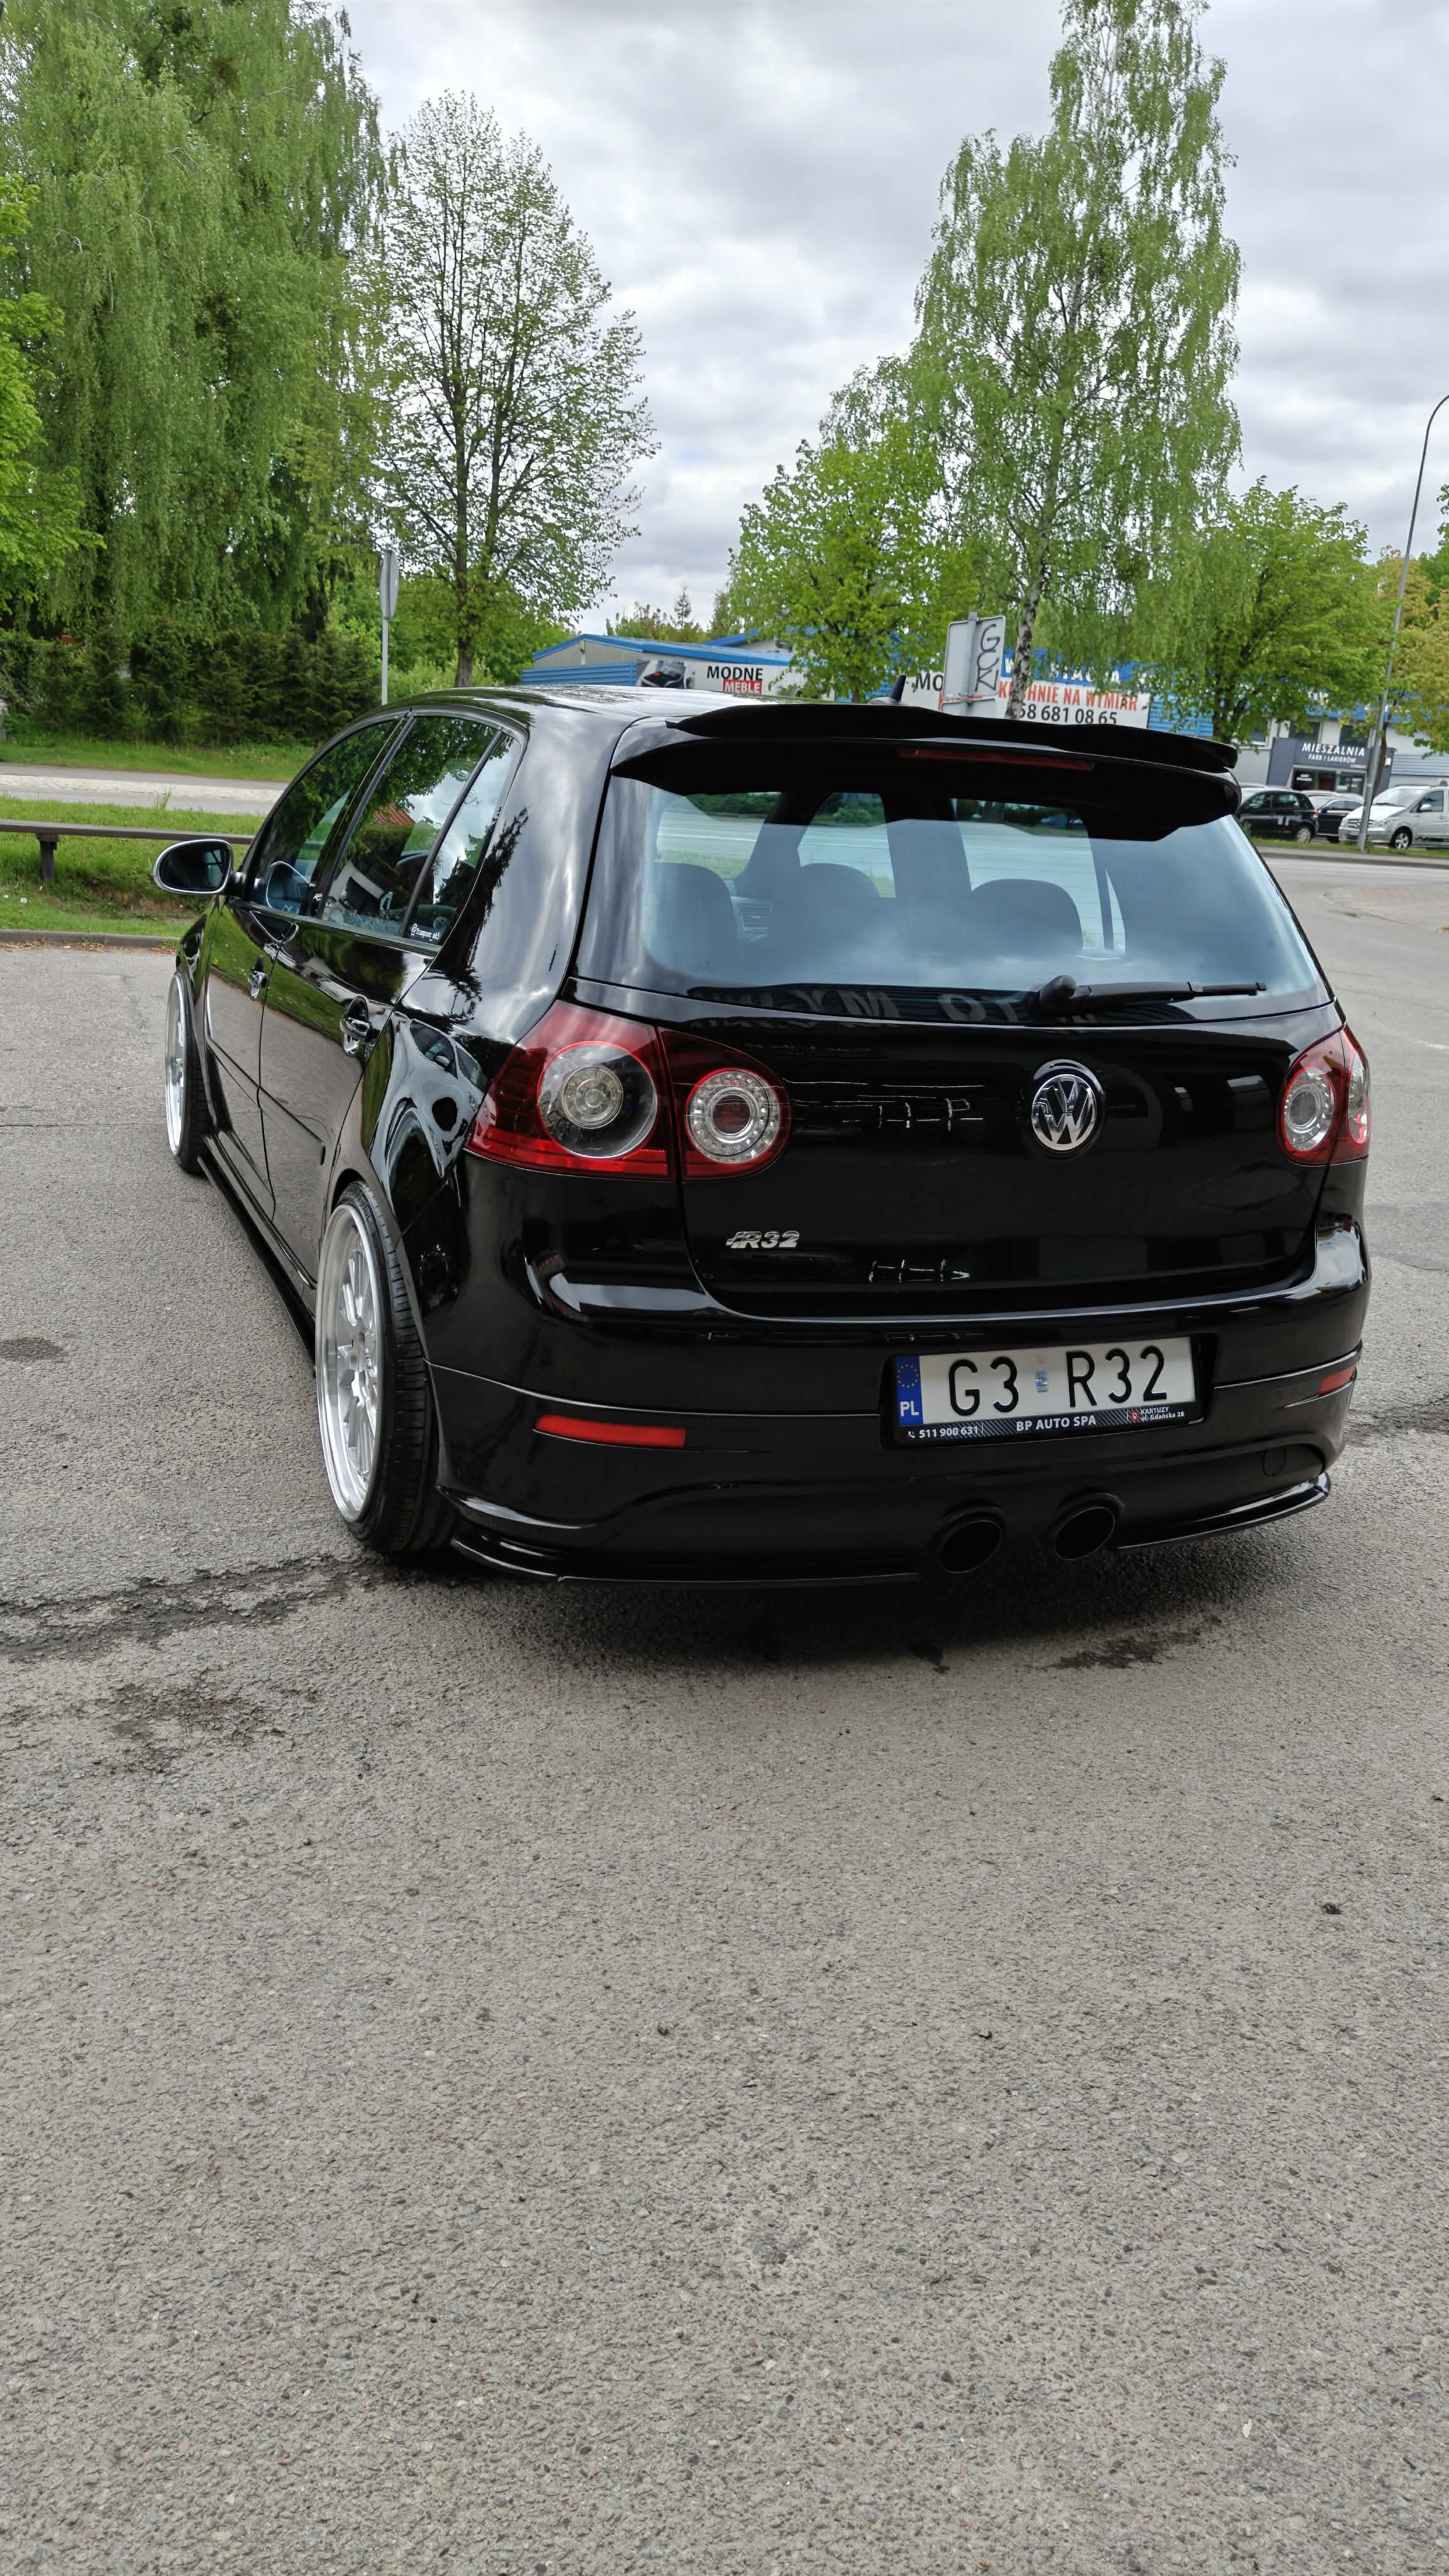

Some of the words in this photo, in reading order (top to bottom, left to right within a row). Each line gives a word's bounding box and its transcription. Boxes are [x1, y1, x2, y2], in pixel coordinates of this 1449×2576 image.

[706, 665, 763, 681] MODNE
[724, 680, 762, 694] MEBLE
[998, 679, 1059, 704] KHNIE
[1063, 687, 1080, 706] NA
[1040, 705, 1069, 723] 681
[1074, 708, 1094, 724] 08
[1098, 710, 1118, 724] 65
[1301, 742, 1365, 757] MIESZALNIA
[726, 1230, 800, 1248] R32
[948, 1356, 1019, 1416] G3
[1065, 1345, 1167, 1407] R32
[900, 1401, 920, 1417] PL
[1141, 1406, 1169, 1414] KARTUZY
[1016, 1421, 1032, 1431] BP
[1036, 1417, 1070, 1430] AUTO
[1074, 1414, 1096, 1426] SPA
[919, 1428, 937, 1438] 511
[940, 1427, 959, 1436] 900
[960, 1426, 979, 1435] 631
